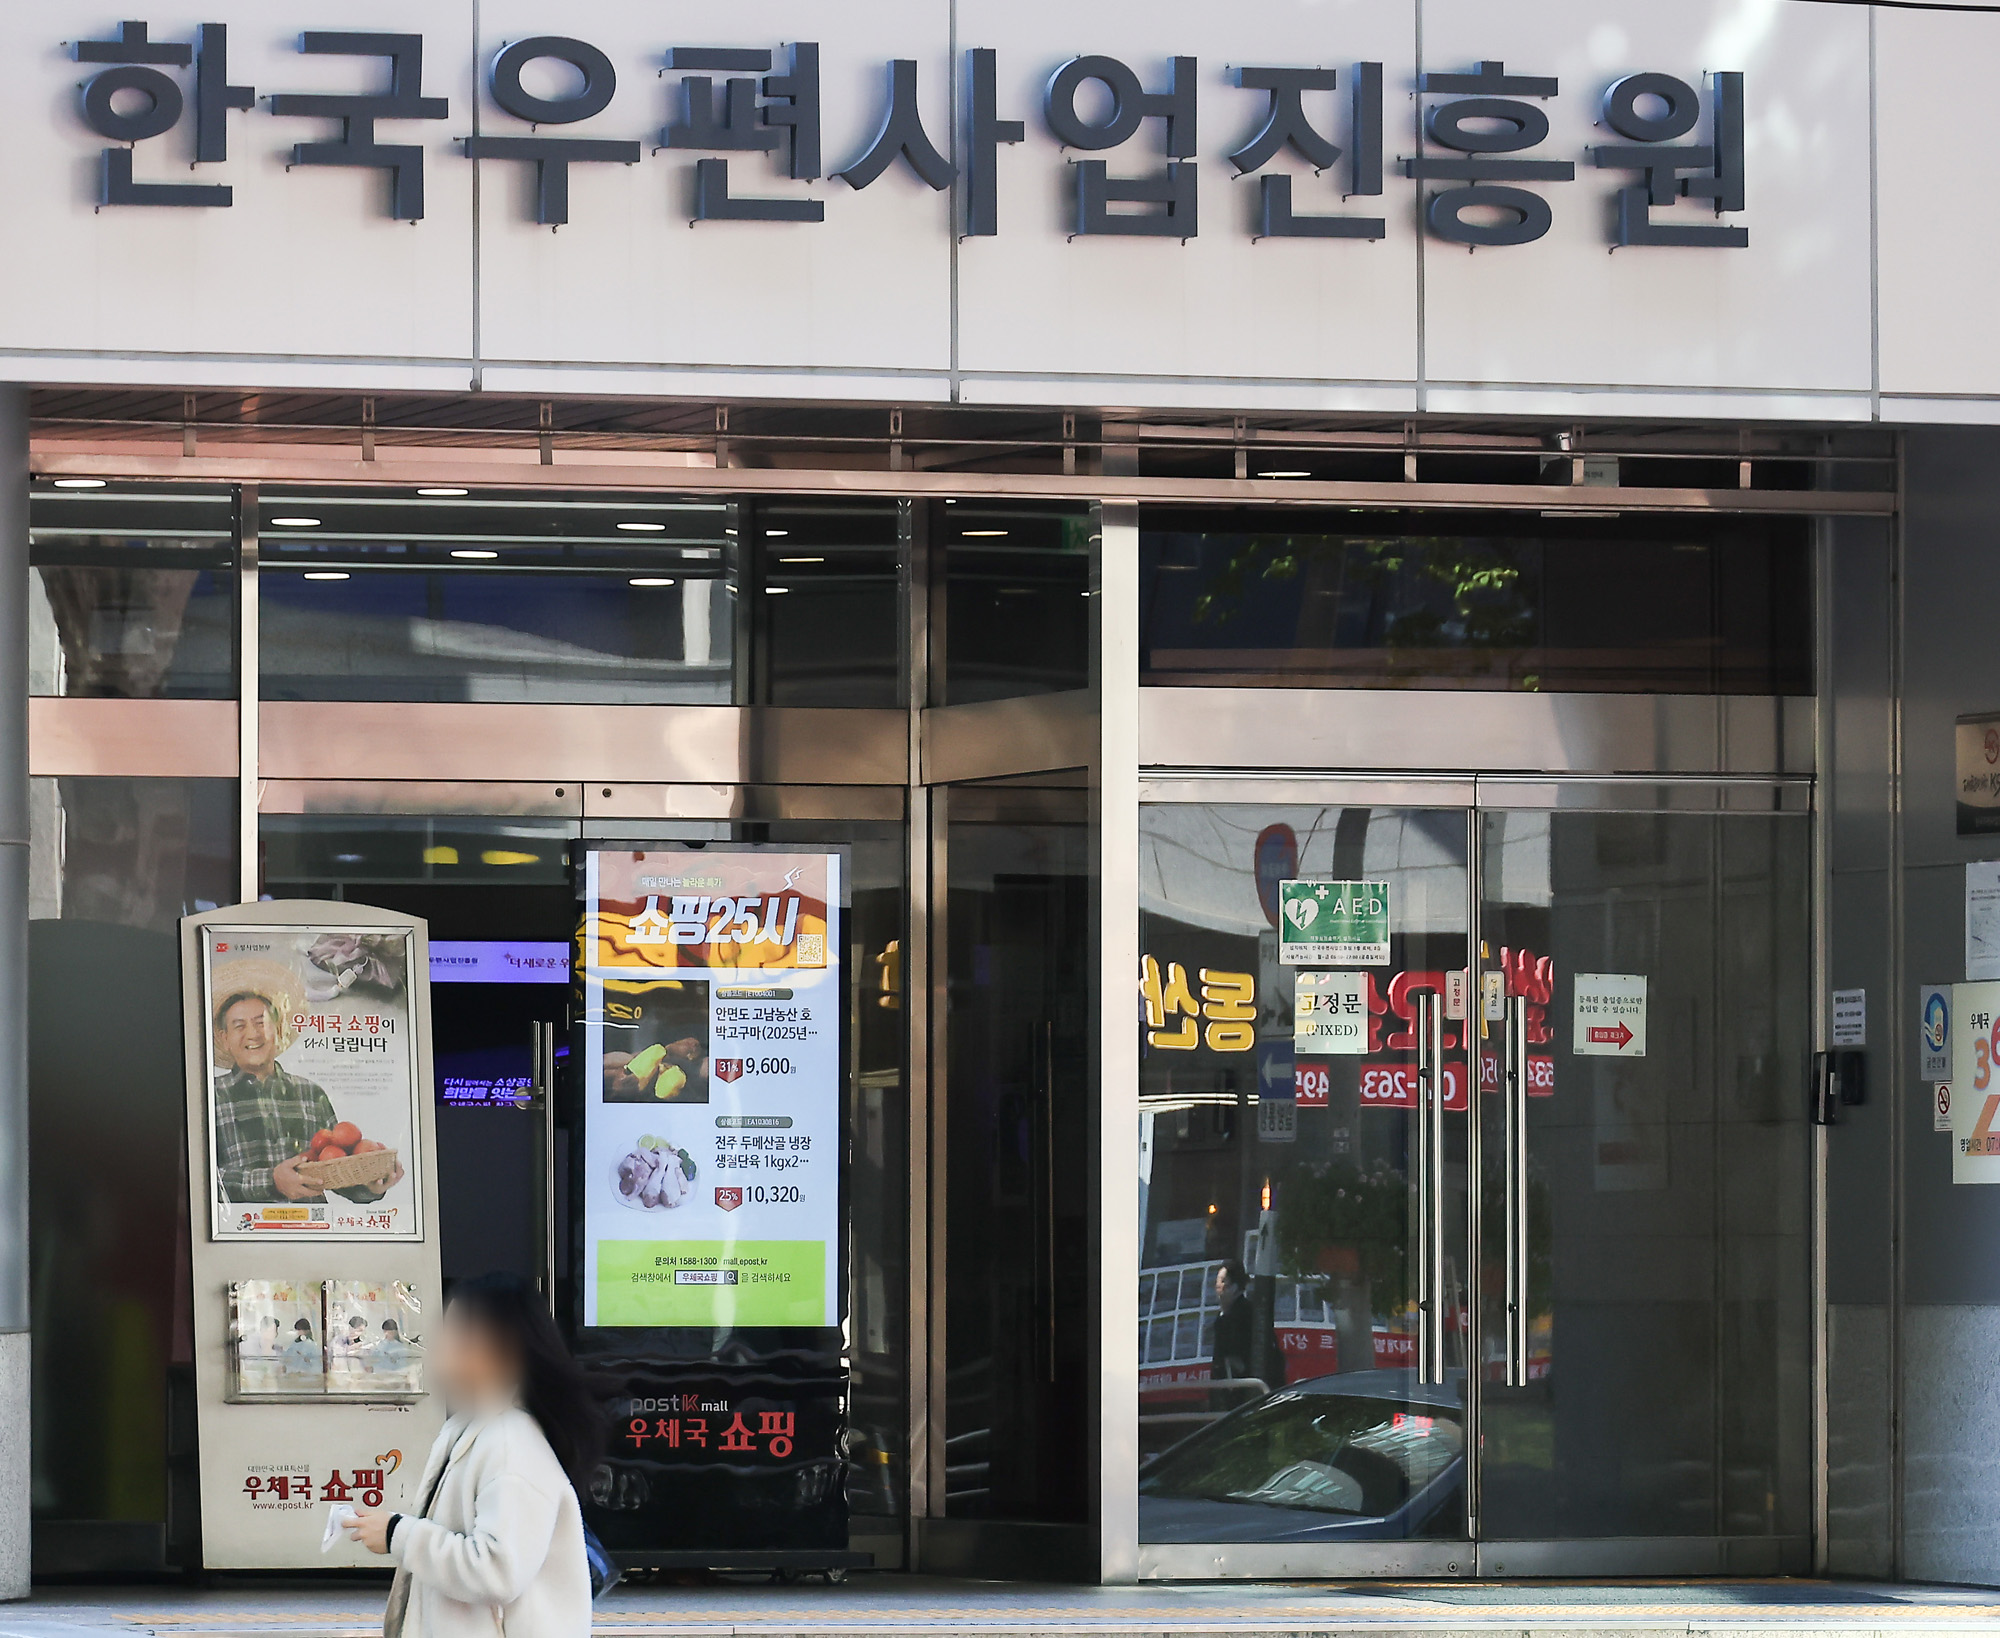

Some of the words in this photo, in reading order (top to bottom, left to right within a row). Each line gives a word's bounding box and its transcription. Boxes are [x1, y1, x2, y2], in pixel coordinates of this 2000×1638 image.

[73, 20, 1749, 249] 한국우편사업진흥원
[1332, 898, 1382, 915] AED
[625, 895, 800, 946] 쇼핑25시
[1301, 993, 1362, 1014] 고정문
[715, 1007, 750, 1021] 안면도
[752, 1007, 798, 1022] 고남농산
[800, 1007, 812, 1021] 호
[1970, 1012, 1990, 1030] 우체국
[291, 1014, 342, 1033] 우체국
[347, 1014, 395, 1035] 쇼핑이
[1305, 1024, 1359, 1037] (FIXED)
[303, 1036, 329, 1050] 다시
[332, 1036, 388, 1053] 달립니다
[719, 1061, 740, 1073] 31%
[715, 1136, 737, 1150] 전주
[740, 1136, 786, 1150] 두메산골
[789, 1136, 812, 1151] 냉장
[715, 1154, 761, 1169] 생절단육
[719, 1189, 739, 1202] 25%
[366, 1214, 391, 1230] 쇼핑
[654, 1256, 677, 1266] 문의처
[679, 1257, 718, 1266] 1588-1300
[631, 1272, 671, 1283] 검색창에서
[682, 1272, 718, 1283] 우체국쇼핑
[751, 1272, 791, 1283] 검색하세요
[701, 1400, 729, 1412] mall
[625, 1418, 710, 1448] 우체국
[718, 1412, 795, 1458] 쇼핑
[242, 1475, 313, 1500] 우체국
[319, 1469, 384, 1508] 쇼핑
[252, 1501, 314, 1511] www.epost.kr
